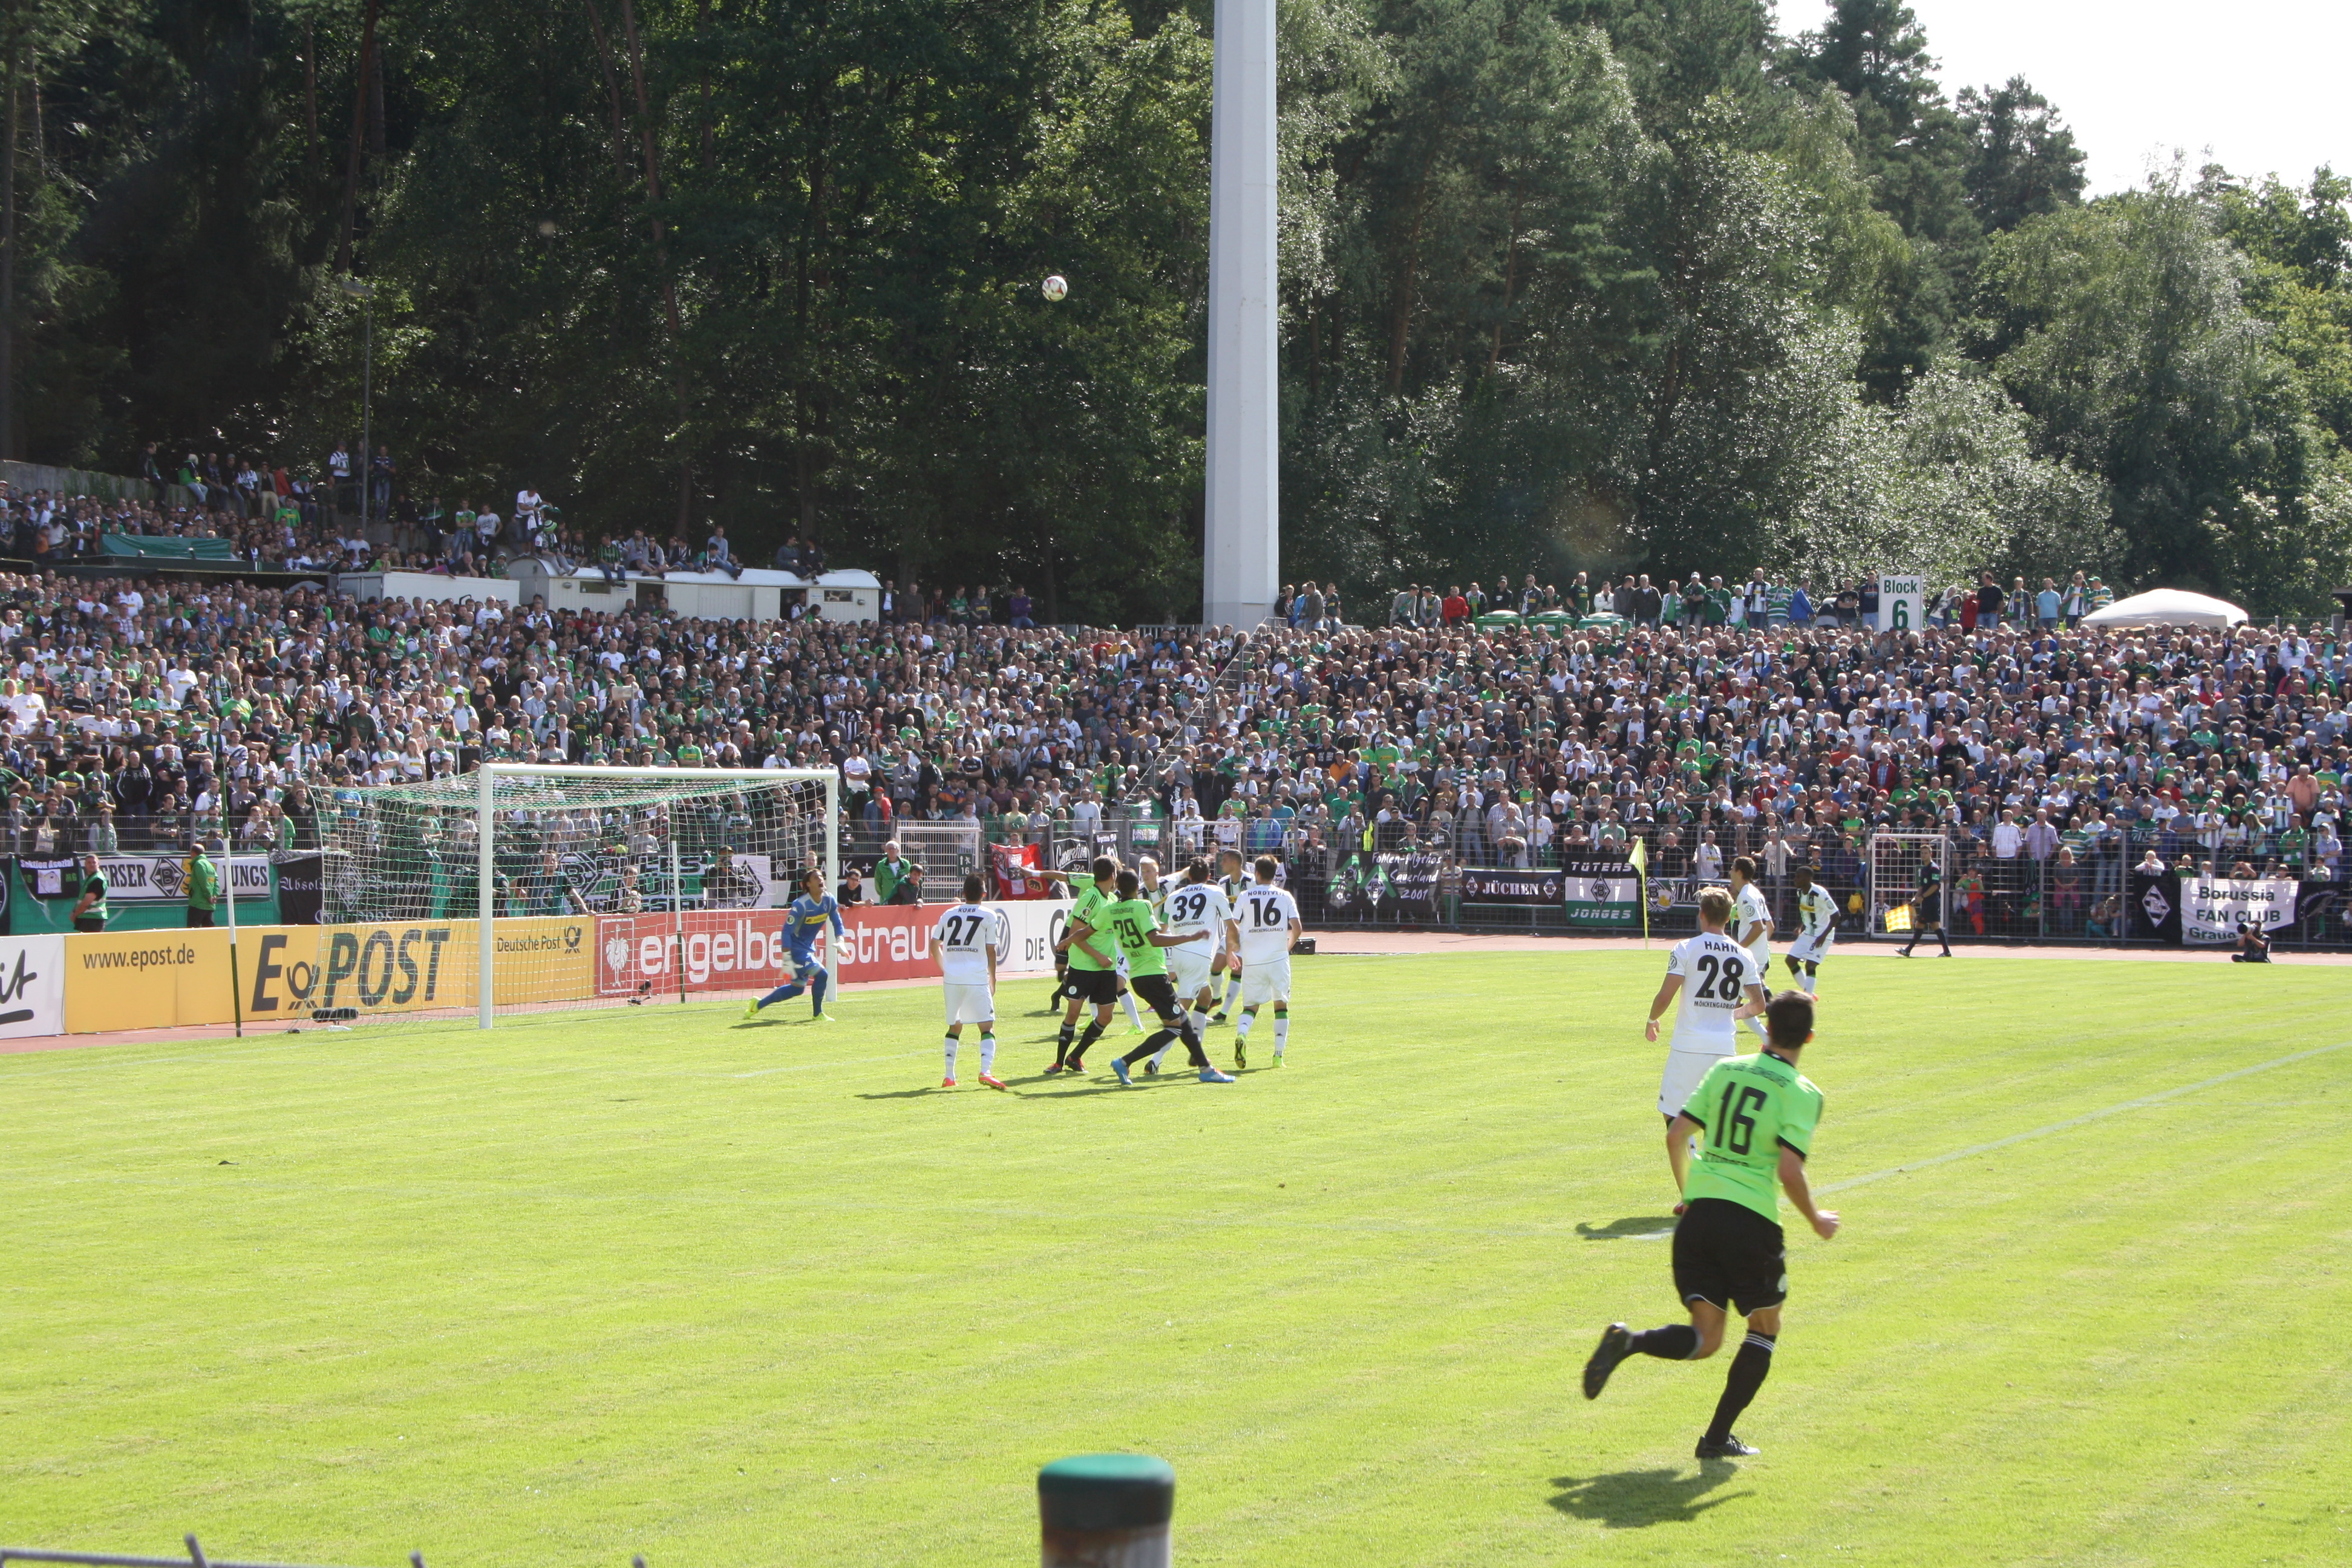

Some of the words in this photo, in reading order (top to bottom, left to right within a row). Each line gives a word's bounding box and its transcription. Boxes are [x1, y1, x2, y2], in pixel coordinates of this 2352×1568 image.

[1884, 580, 1918, 593] Block
[1892, 599, 1908, 630] 6
[1372, 852, 1442, 867] Fohlen-Mythos
[961, 866, 970, 875] 16
[1390, 869, 1439, 883] Sauerland
[1400, 889, 1428, 900] 2001
[1482, 880, 1539, 895] JÜCHEN
[2199, 886, 2275, 901] Borussia
[1172, 893, 1206, 921] 39
[1250, 898, 1281, 927] 16
[1570, 909, 1632, 919] JONGES
[2196, 910, 2229, 922] FAN
[2235, 909, 2281, 923] CLUB
[947, 915, 984, 946] 27
[1113, 918, 1145, 949] 29
[497, 935, 539, 952] Deutsche
[541, 936, 560, 950] Post
[640, 919, 826, 984] engelbet
[837, 921, 941, 965] strau
[1025, 938, 1045, 961] DIE
[1704, 941, 1739, 954] HAHN
[83, 943, 195, 972] www.epost.de
[1694, 955, 1743, 1001] 28
[1714, 1082, 1768, 1156] 16
